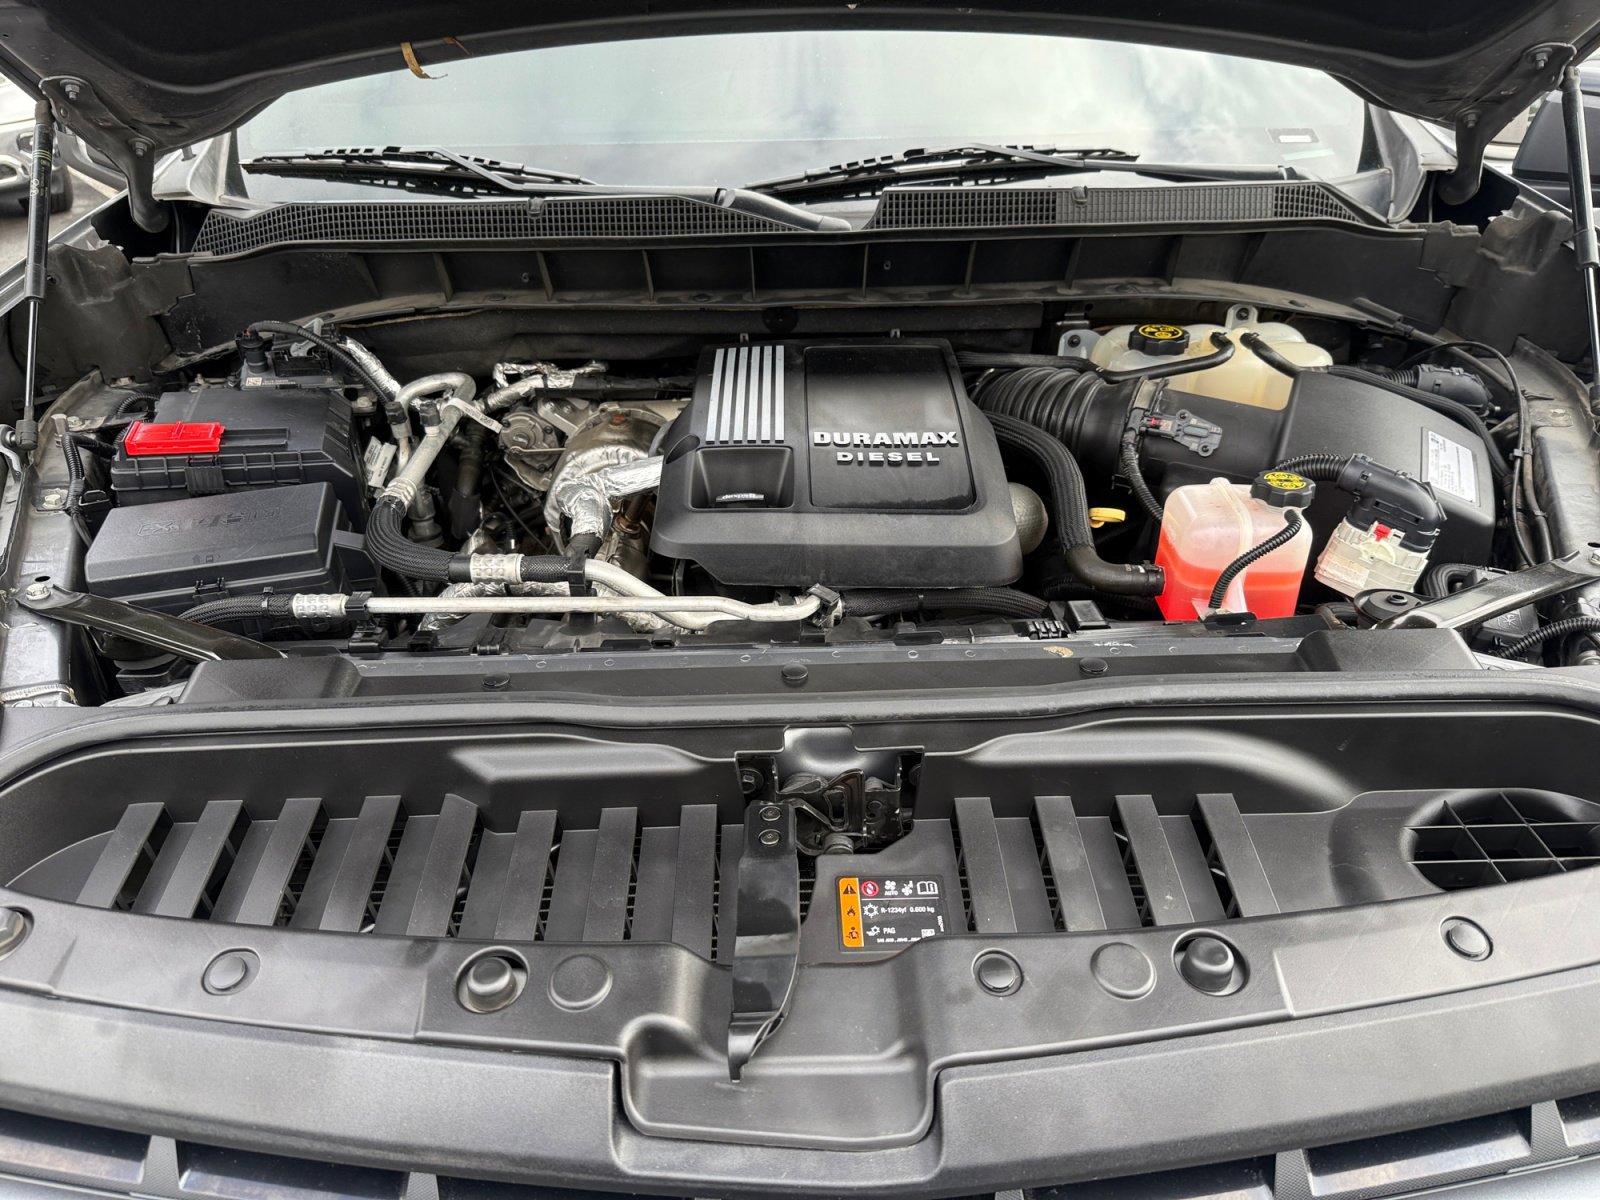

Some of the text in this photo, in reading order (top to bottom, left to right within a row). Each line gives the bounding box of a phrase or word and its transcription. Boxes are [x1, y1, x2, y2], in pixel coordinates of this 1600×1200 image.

[813, 431, 959, 447] DURAMAX
[836, 452, 940, 466] DIESEL
[880, 906, 907, 914] R-1234yf
[926, 905, 935, 914] kg
